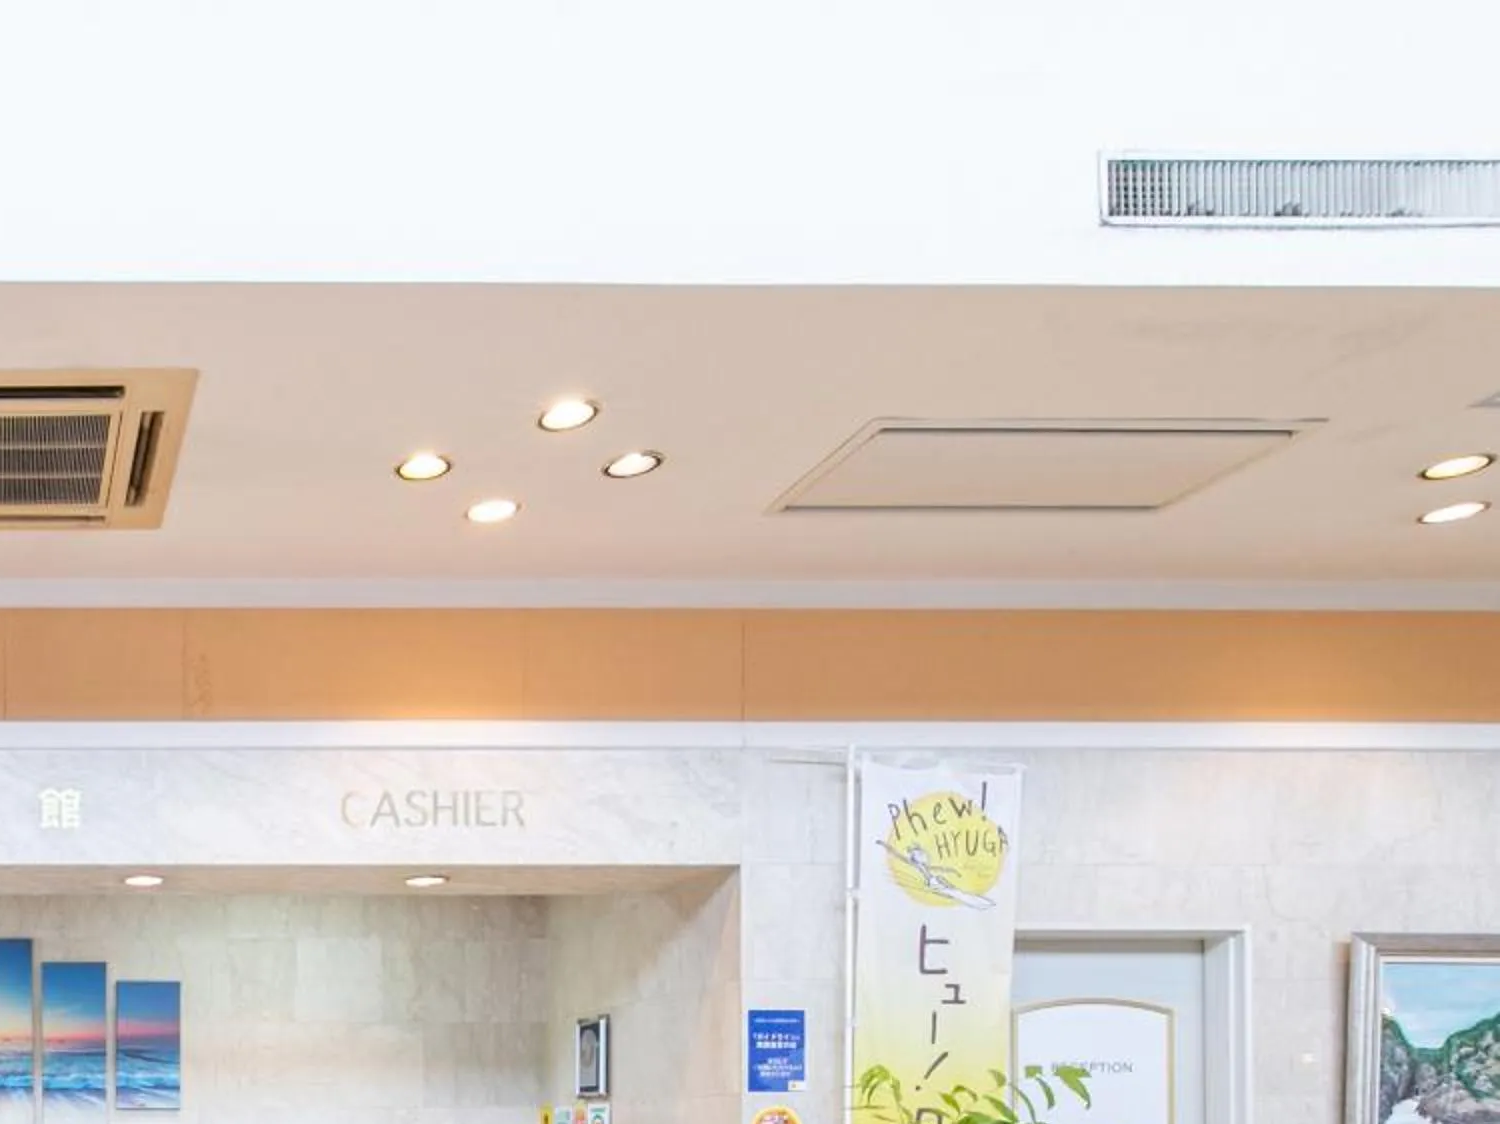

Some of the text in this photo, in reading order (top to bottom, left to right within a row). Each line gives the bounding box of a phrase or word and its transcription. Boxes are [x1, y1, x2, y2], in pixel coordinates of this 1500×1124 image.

[340, 789, 526, 829] CASHIER
[887, 780, 988, 841] Phew!
[934, 825, 1010, 861] HYUGA
